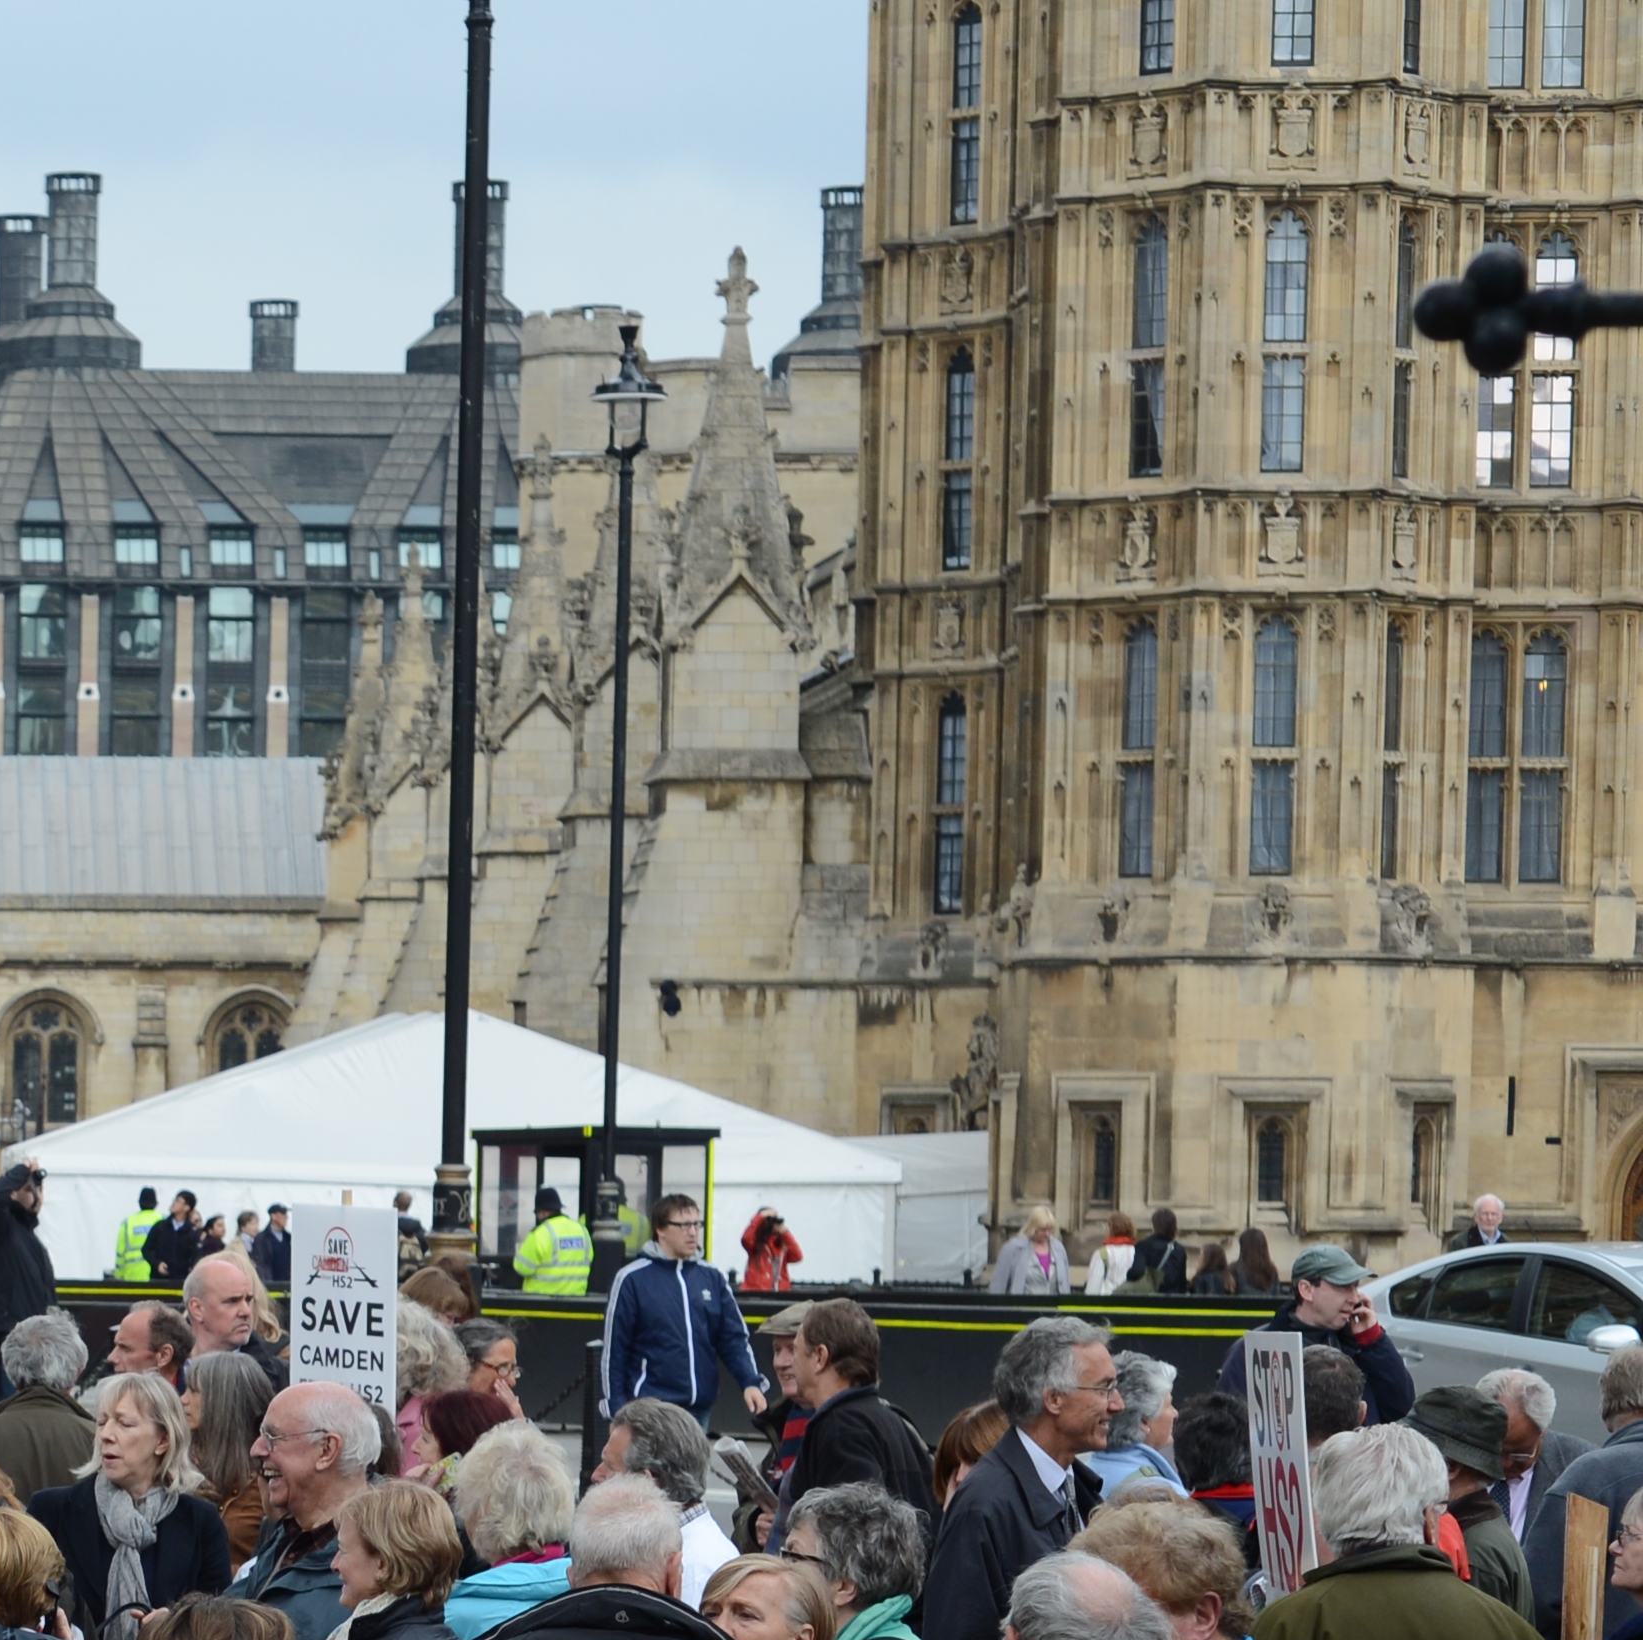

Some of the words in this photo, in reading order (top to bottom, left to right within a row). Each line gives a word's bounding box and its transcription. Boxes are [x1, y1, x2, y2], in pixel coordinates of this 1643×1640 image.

[327, 1239, 349, 1256] SAVE
[332, 1275, 353, 1289] HS2
[301, 1296, 385, 1338] SAVE
[299, 1344, 384, 1372] CAMDEN
[1252, 1348, 1294, 1452] STOP
[1258, 1455, 1306, 1593] HS2
